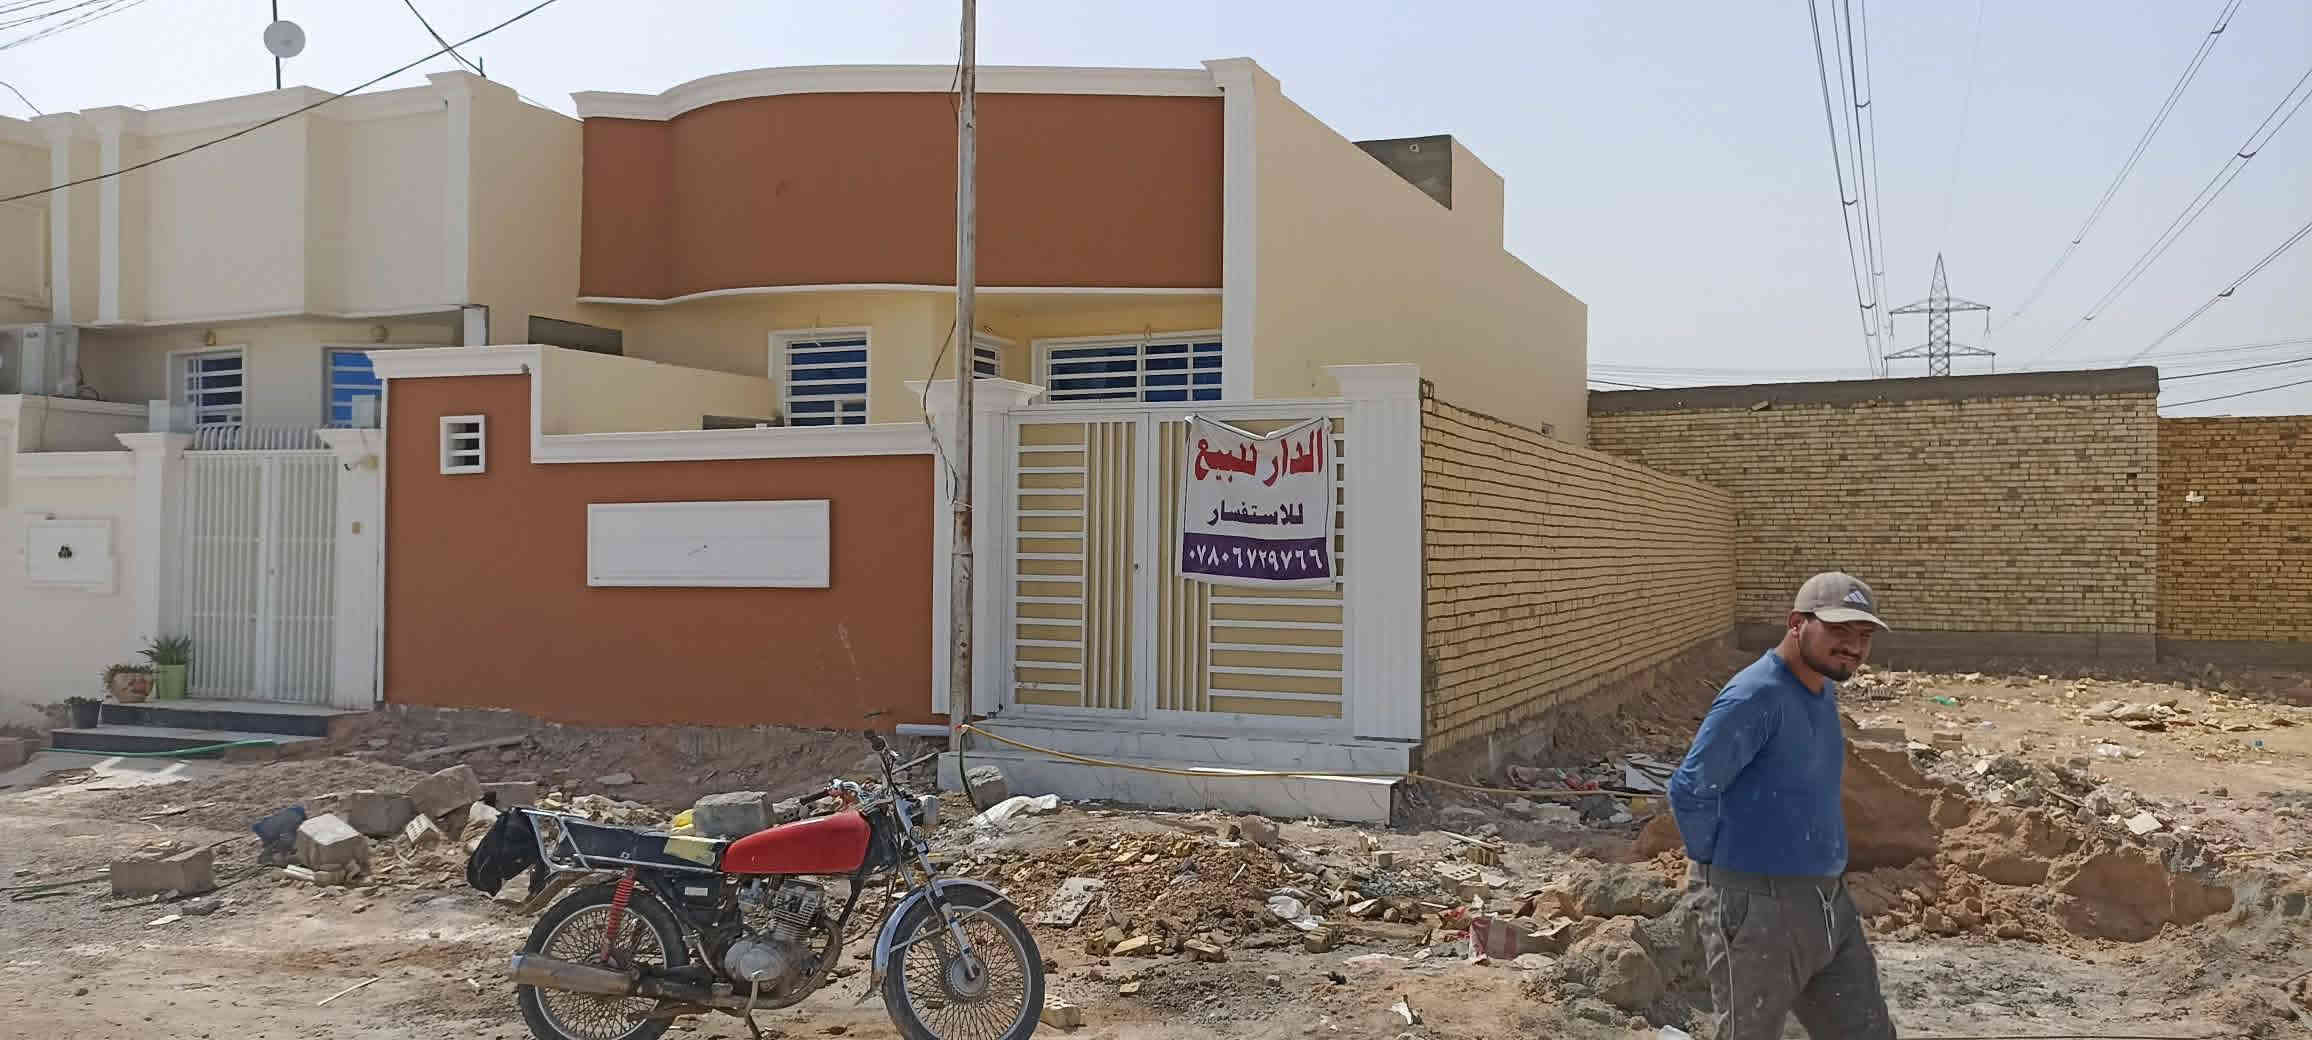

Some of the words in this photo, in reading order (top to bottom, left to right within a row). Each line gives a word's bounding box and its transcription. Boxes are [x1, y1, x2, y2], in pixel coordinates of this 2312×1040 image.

[1194, 438, 1258, 483] للبيع
[1264, 428, 1324, 487] الدار
[1207, 499, 1304, 526] للاستفسار
